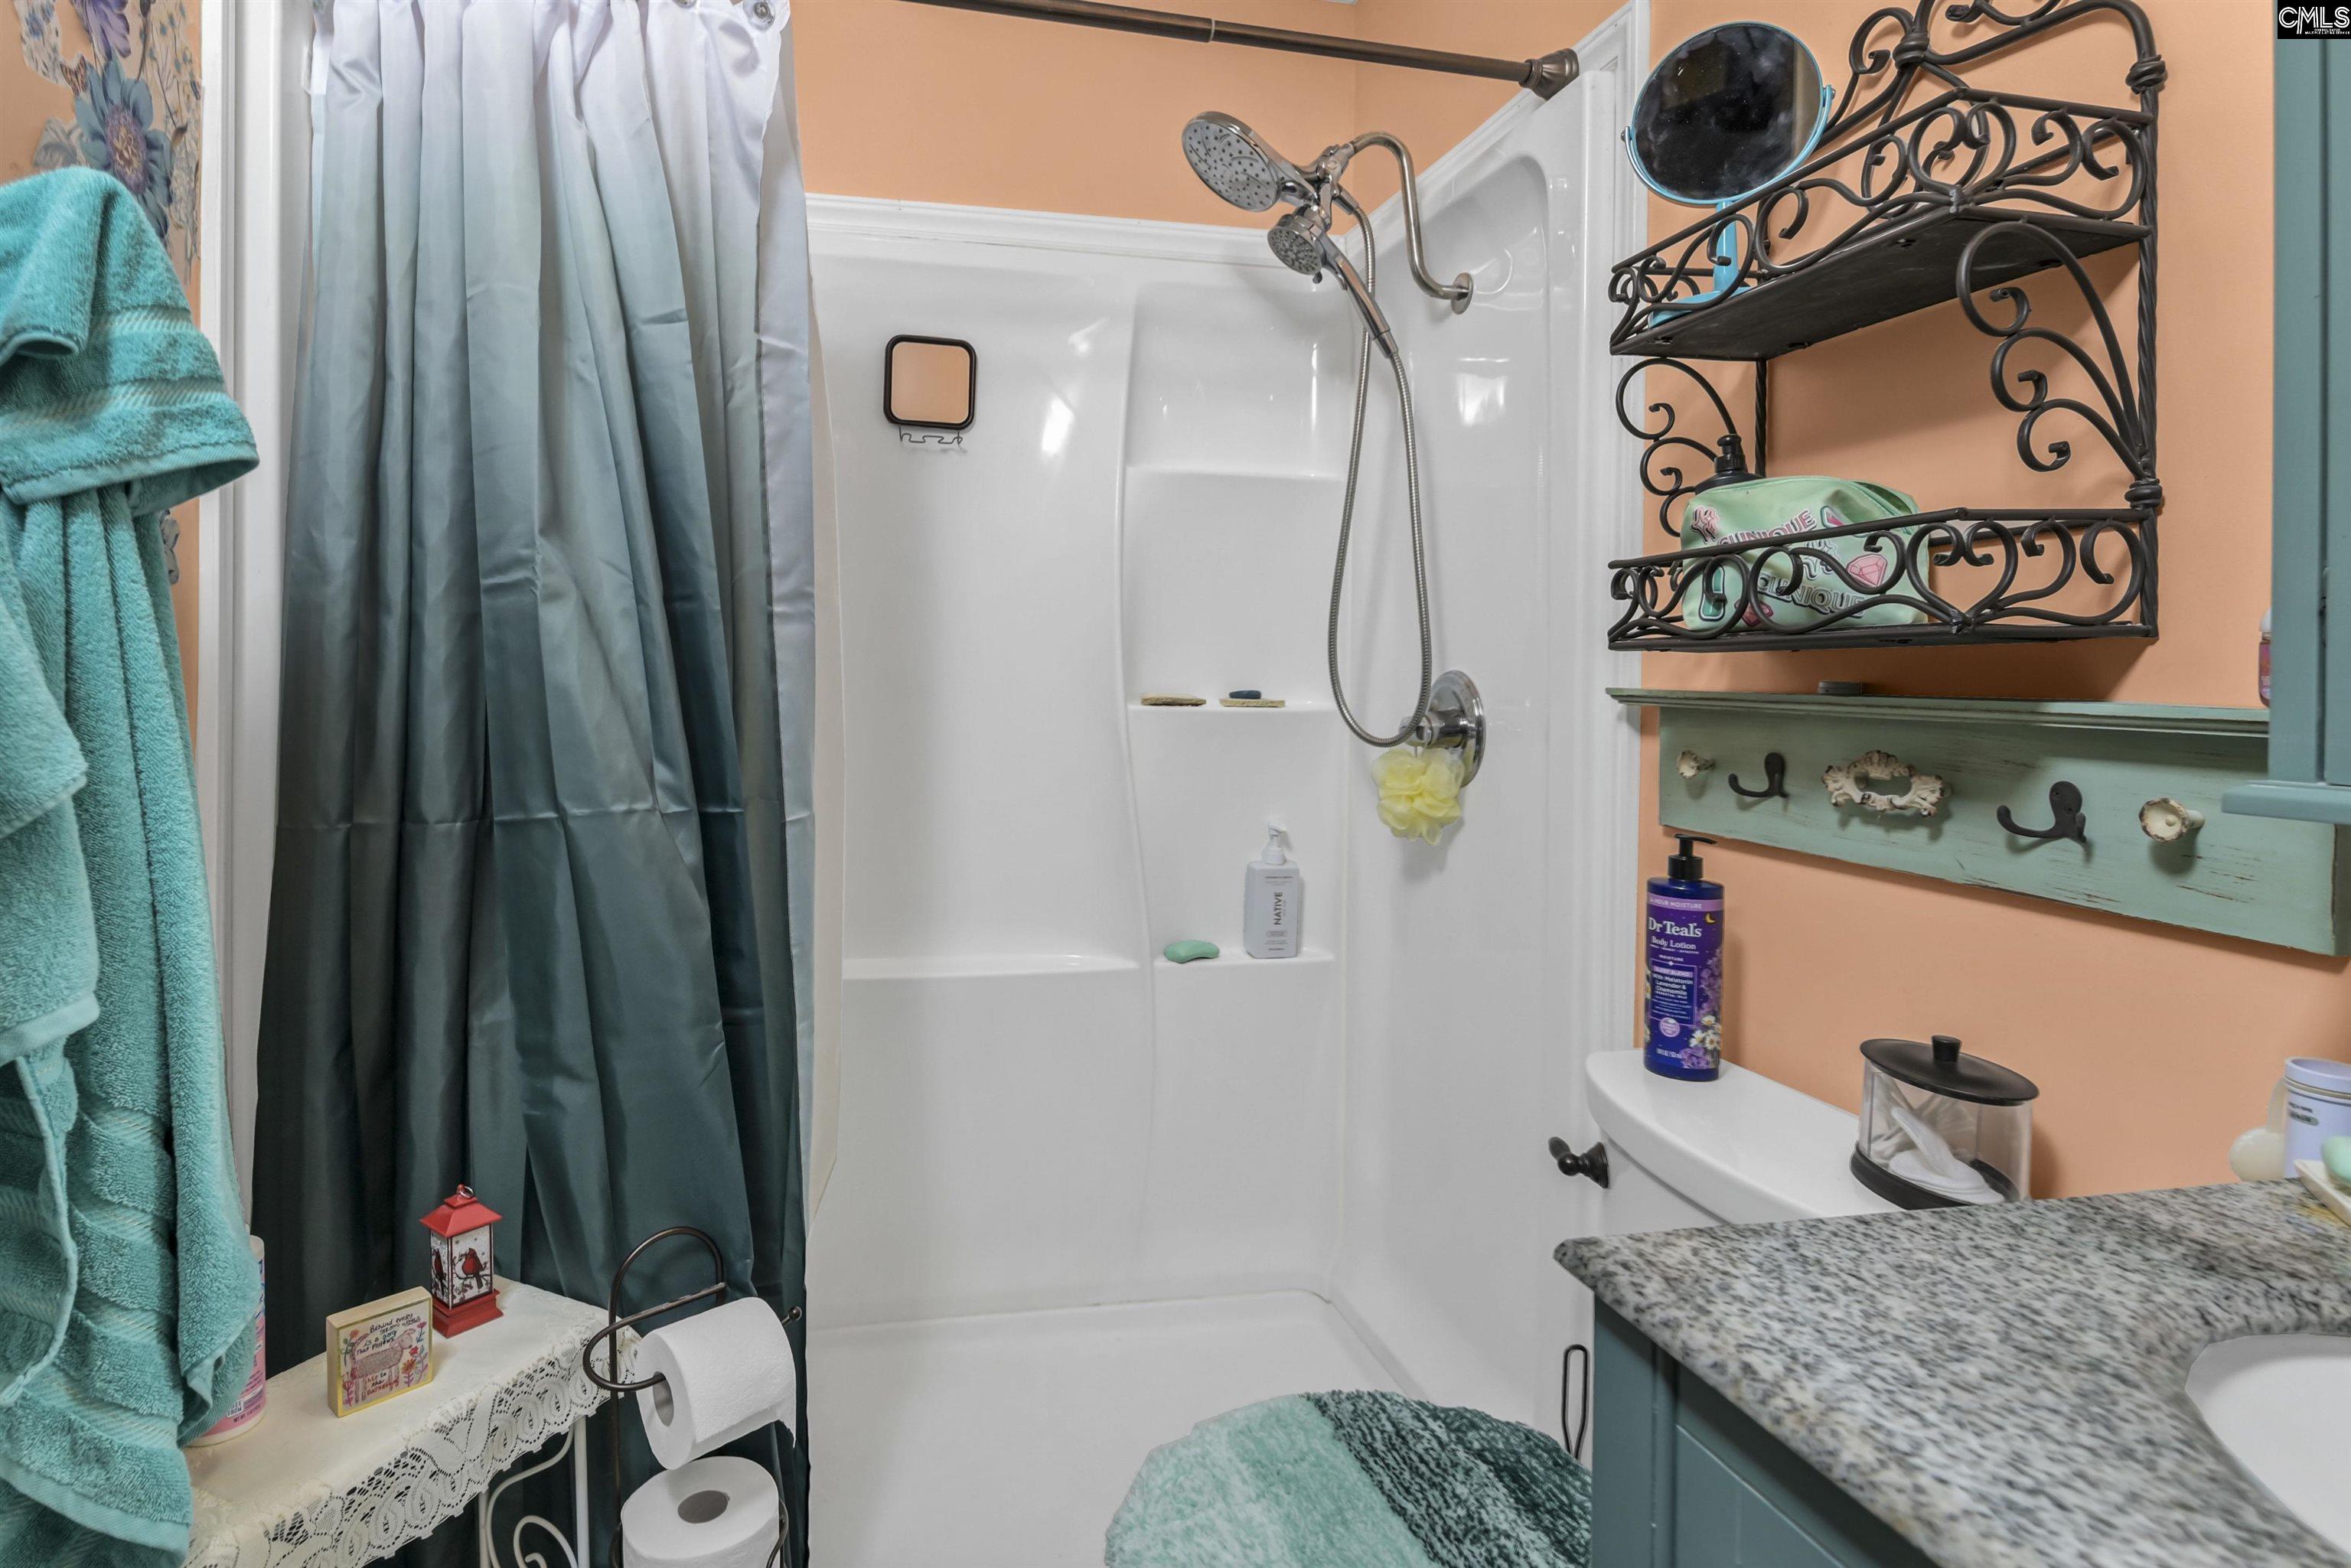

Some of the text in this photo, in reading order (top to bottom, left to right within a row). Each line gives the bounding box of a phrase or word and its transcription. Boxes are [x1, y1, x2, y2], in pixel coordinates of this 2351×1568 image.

[1273, 892, 1283, 925] NATIVE
[1648, 916, 1703, 938] Dr Teal's
[1651, 935, 1668, 947] Body
[1669, 940, 1697, 950] Lotion
[1655, 986, 1687, 996] Chamomile
[370, 1319, 393, 1333] Behind
[227, 1406, 242, 1416] FROM
